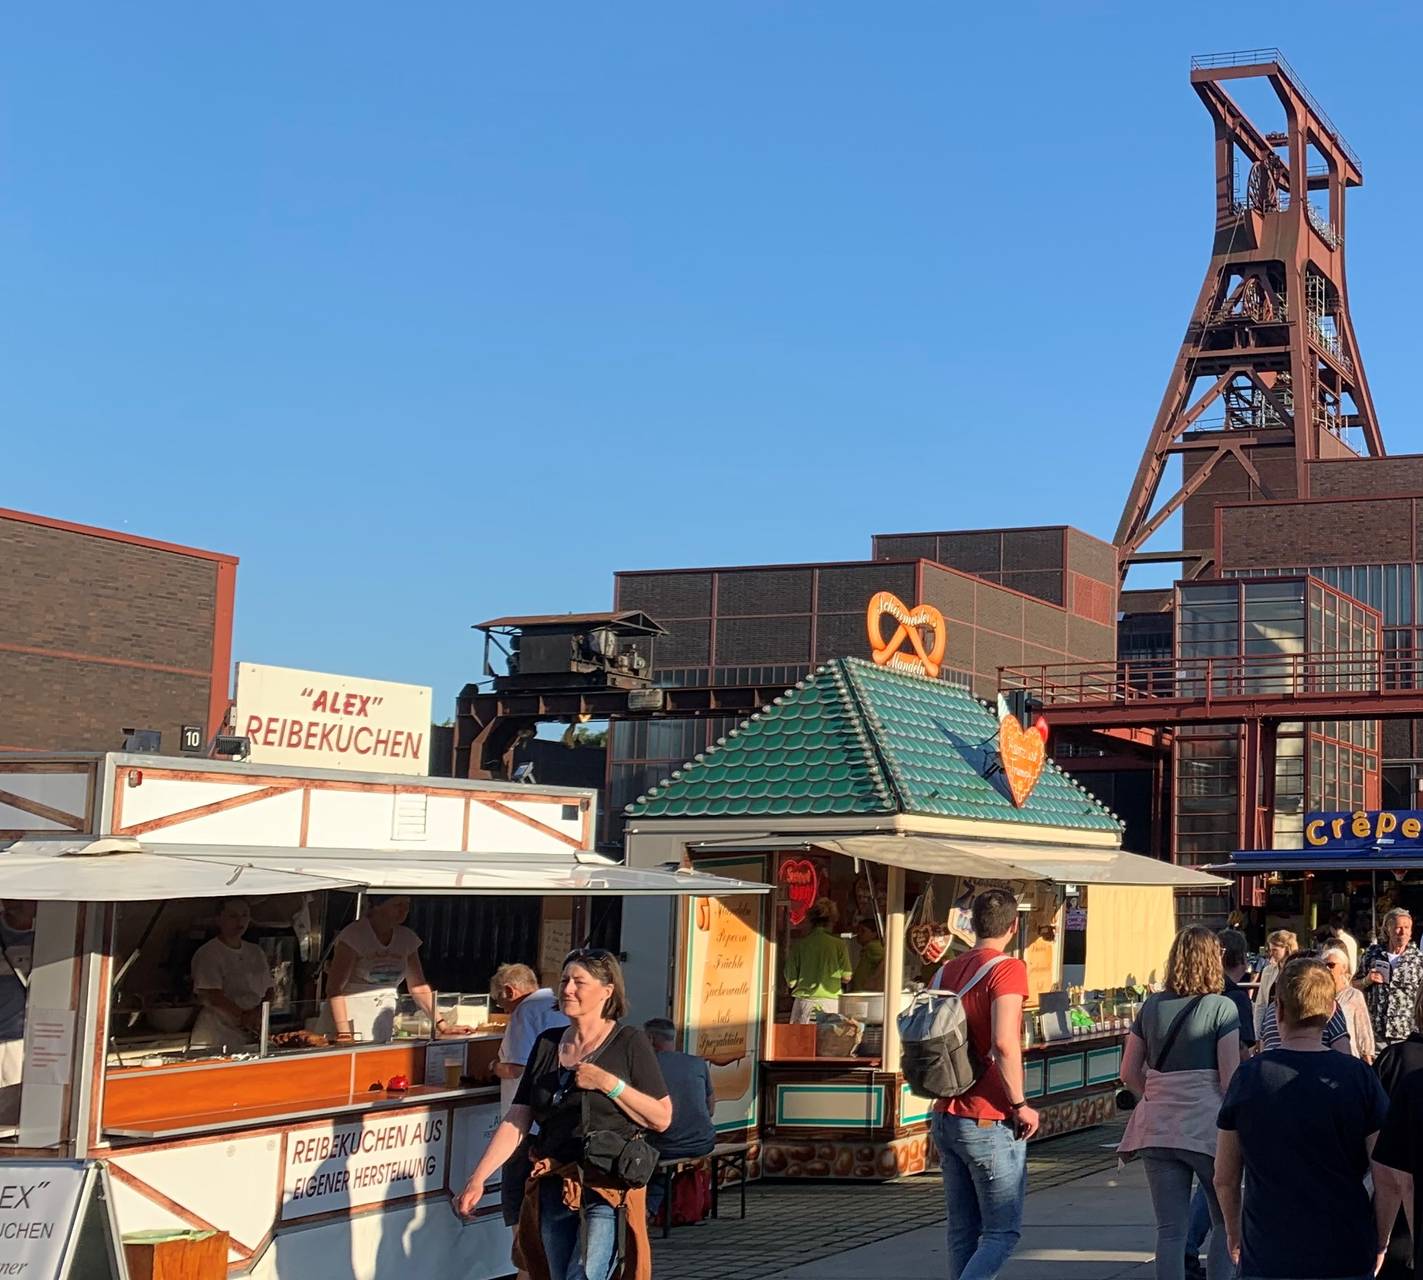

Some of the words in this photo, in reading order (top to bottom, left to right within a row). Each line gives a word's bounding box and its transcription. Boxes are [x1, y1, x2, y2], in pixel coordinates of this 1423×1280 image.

[185, 730, 200, 747] 10
[246, 715, 423, 760] REIBEKUCHEN
[292, 1126, 408, 1165] REIBEKUCHEN
[409, 1119, 444, 1146] AUS
[292, 1169, 350, 1201] EIGENER
[353, 1155, 437, 1190] HERSTELLUNG
